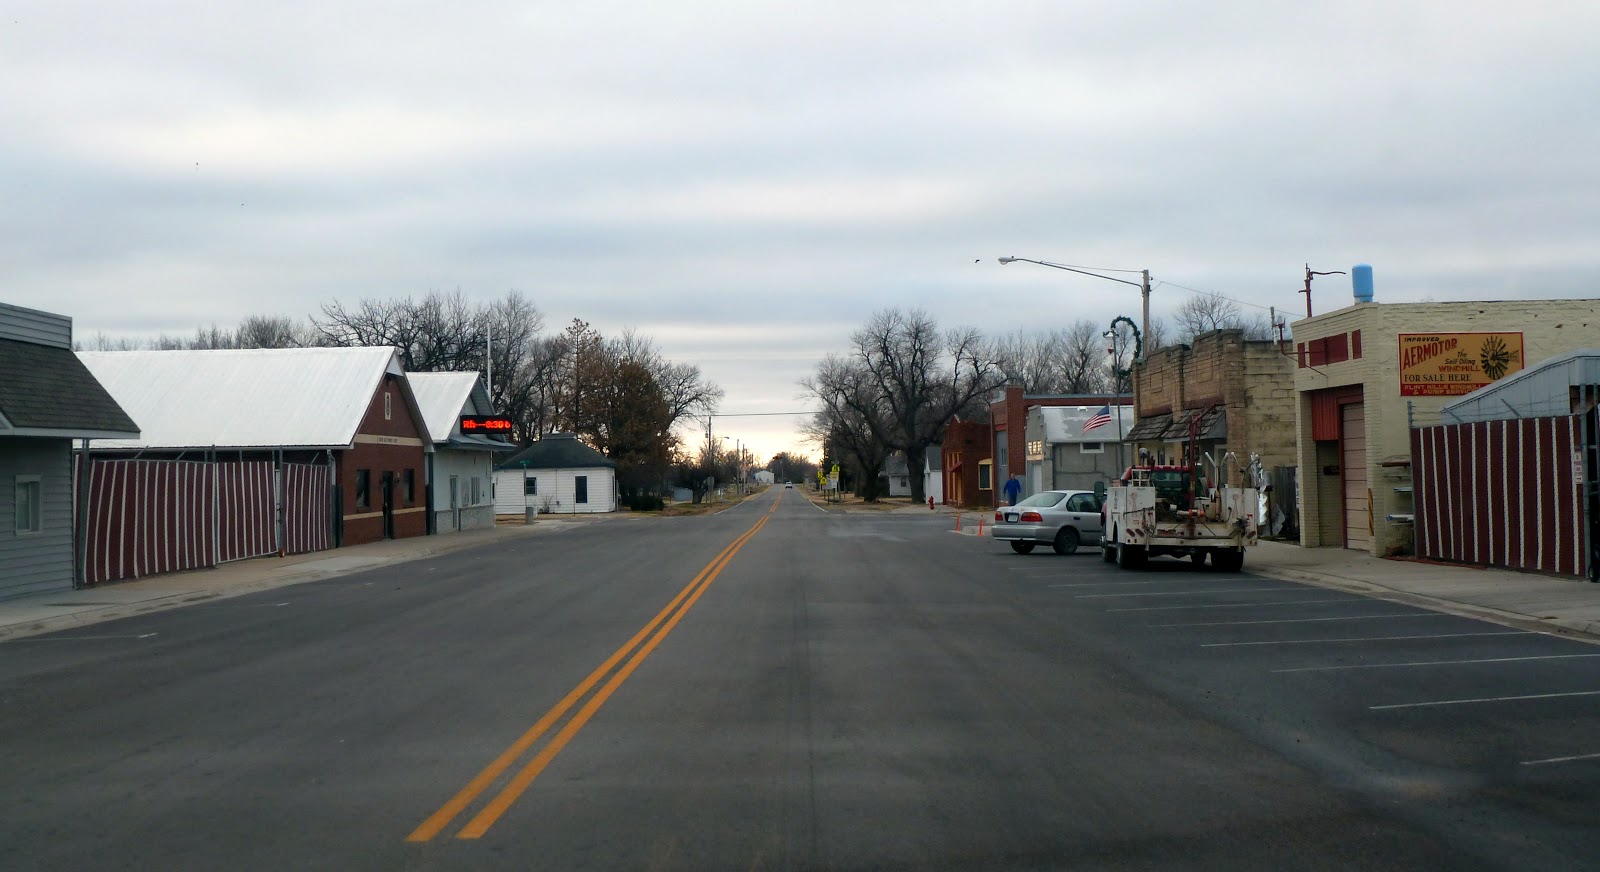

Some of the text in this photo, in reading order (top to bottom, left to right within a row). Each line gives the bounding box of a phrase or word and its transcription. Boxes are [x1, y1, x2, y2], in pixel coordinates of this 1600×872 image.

[1403, 338, 1457, 370] AERMOTOR
[1457, 348, 1467, 357] The
[1404, 374, 1472, 382] FOR SALE HERE
